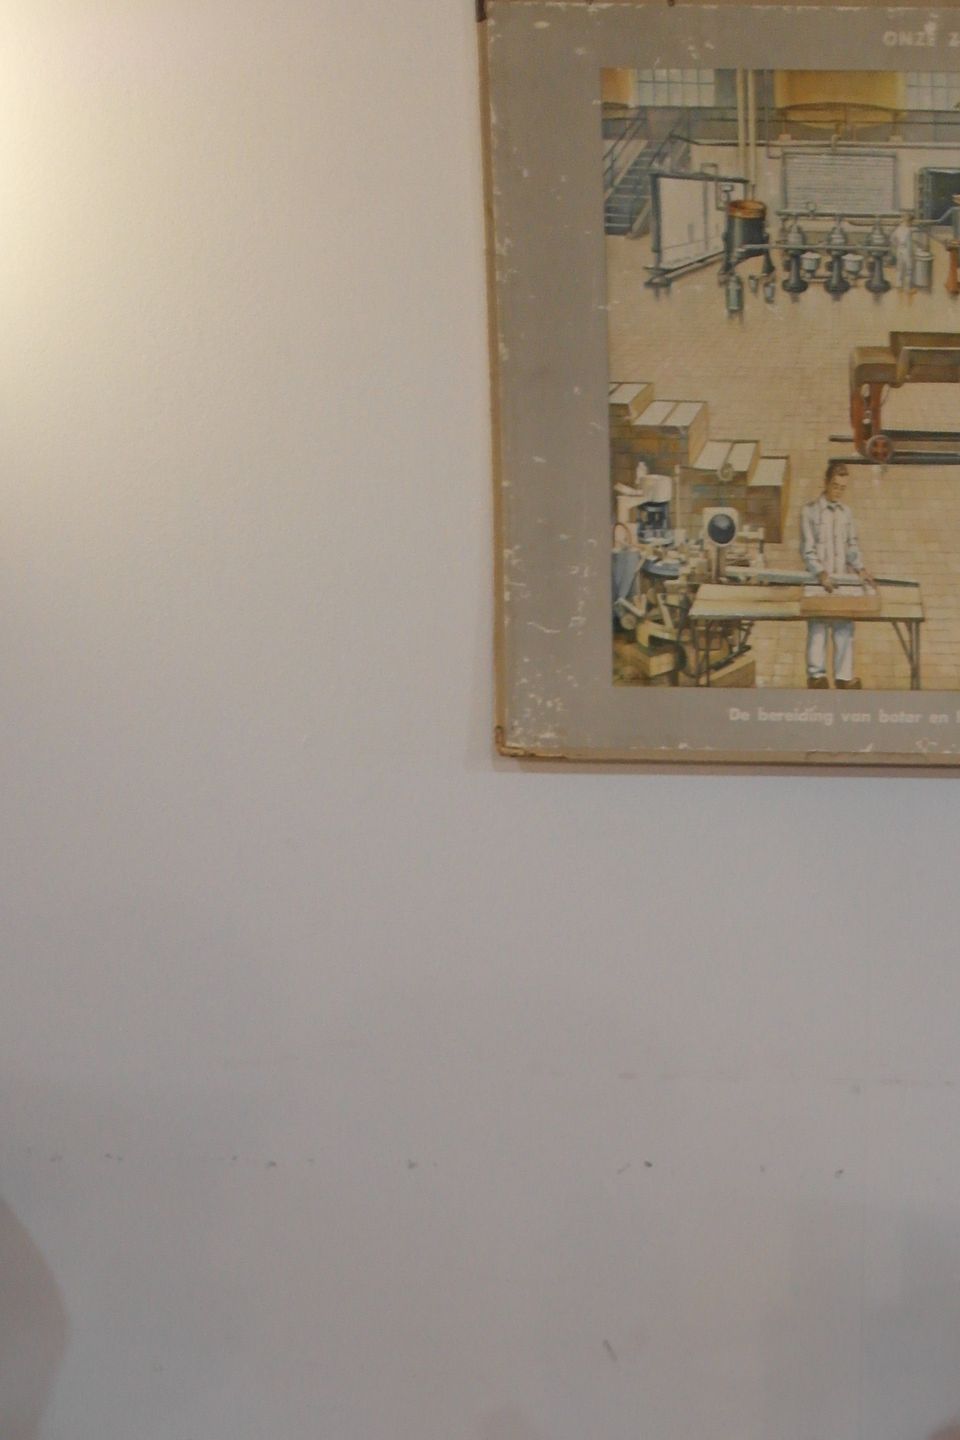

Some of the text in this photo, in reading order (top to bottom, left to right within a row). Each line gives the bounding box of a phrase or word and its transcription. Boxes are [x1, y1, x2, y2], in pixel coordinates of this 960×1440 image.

[883, 31, 936, 47] ONZE
[729, 708, 750, 721] De
[757, 706, 834, 726] bereiding
[841, 712, 871, 723] van
[878, 709, 922, 723] boter
[929, 713, 949, 723] en
